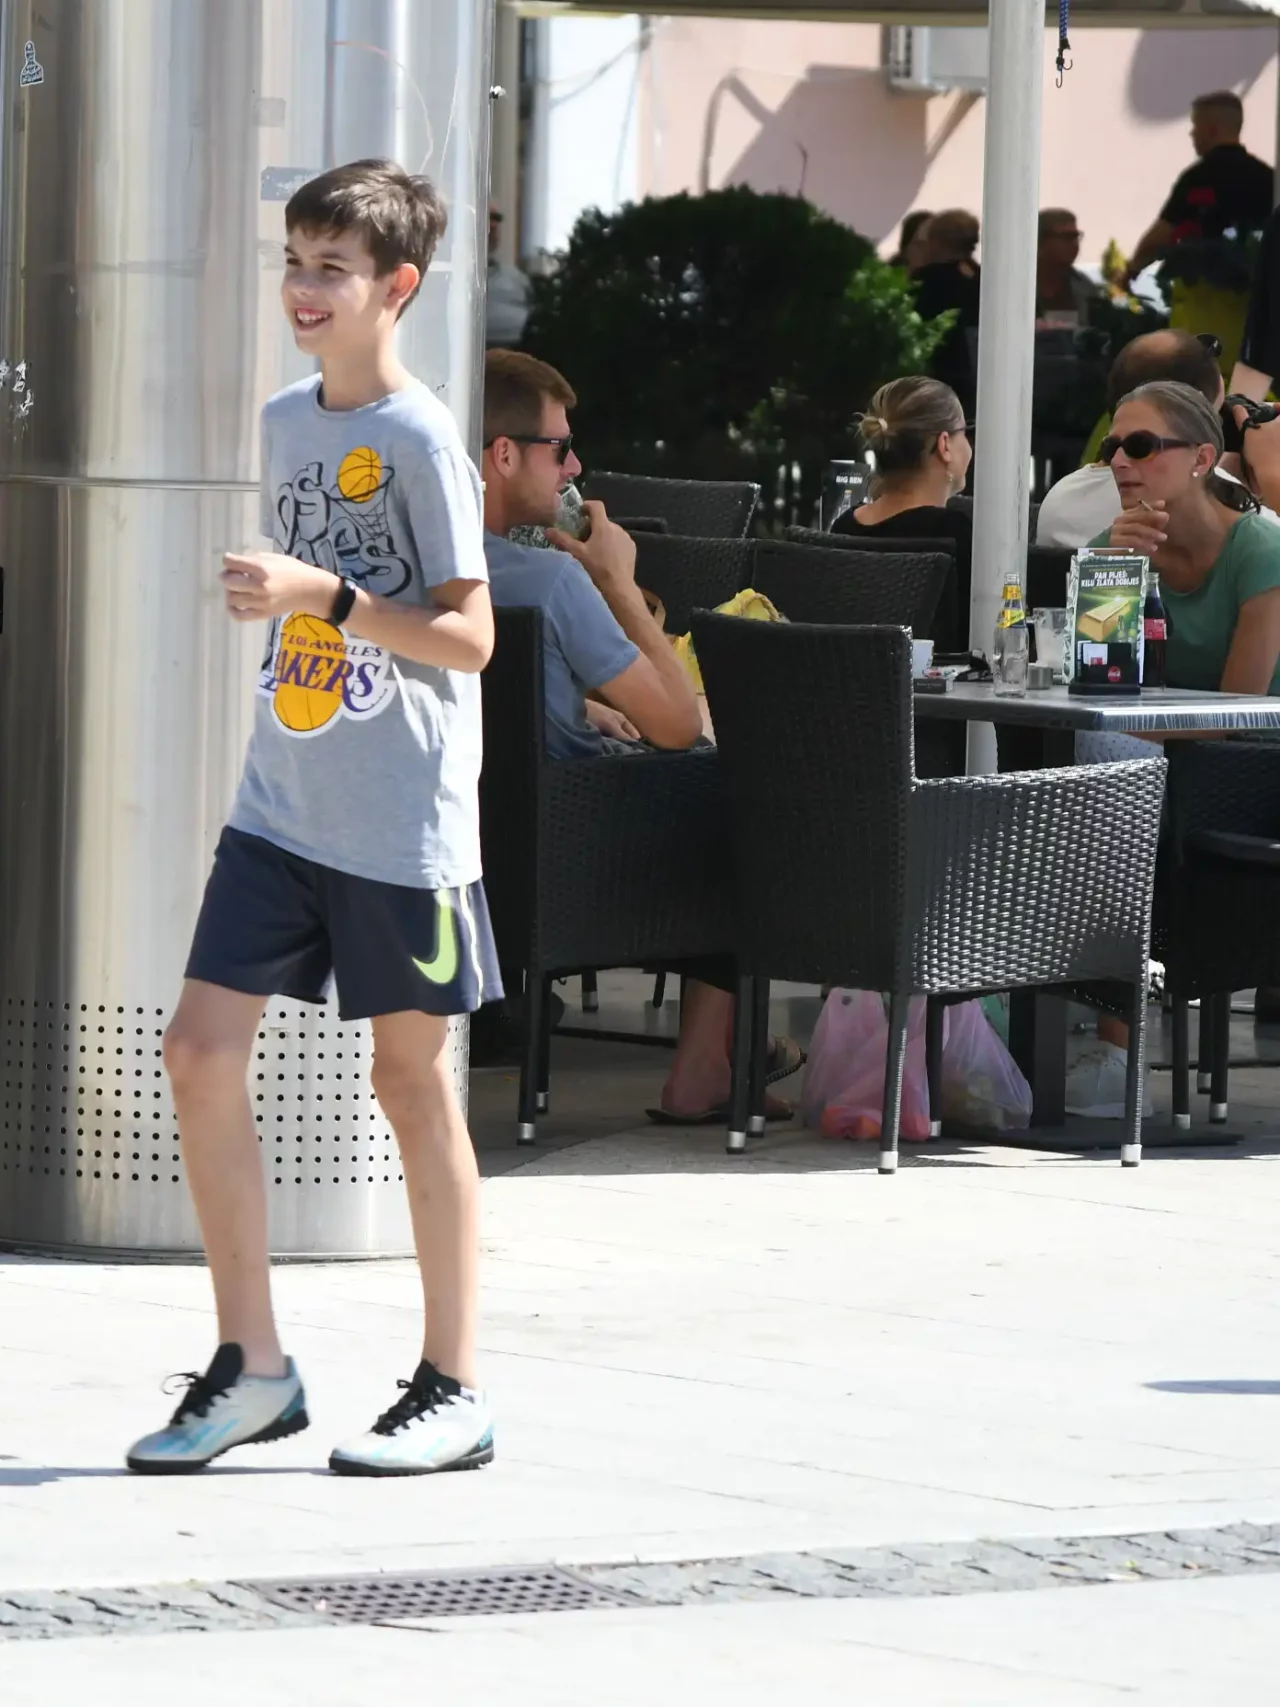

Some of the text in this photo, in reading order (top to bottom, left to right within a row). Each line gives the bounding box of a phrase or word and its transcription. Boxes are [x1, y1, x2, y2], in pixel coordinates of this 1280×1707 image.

[836, 475, 863, 484] BIG BEN
[309, 639, 384, 658] ANGELES
